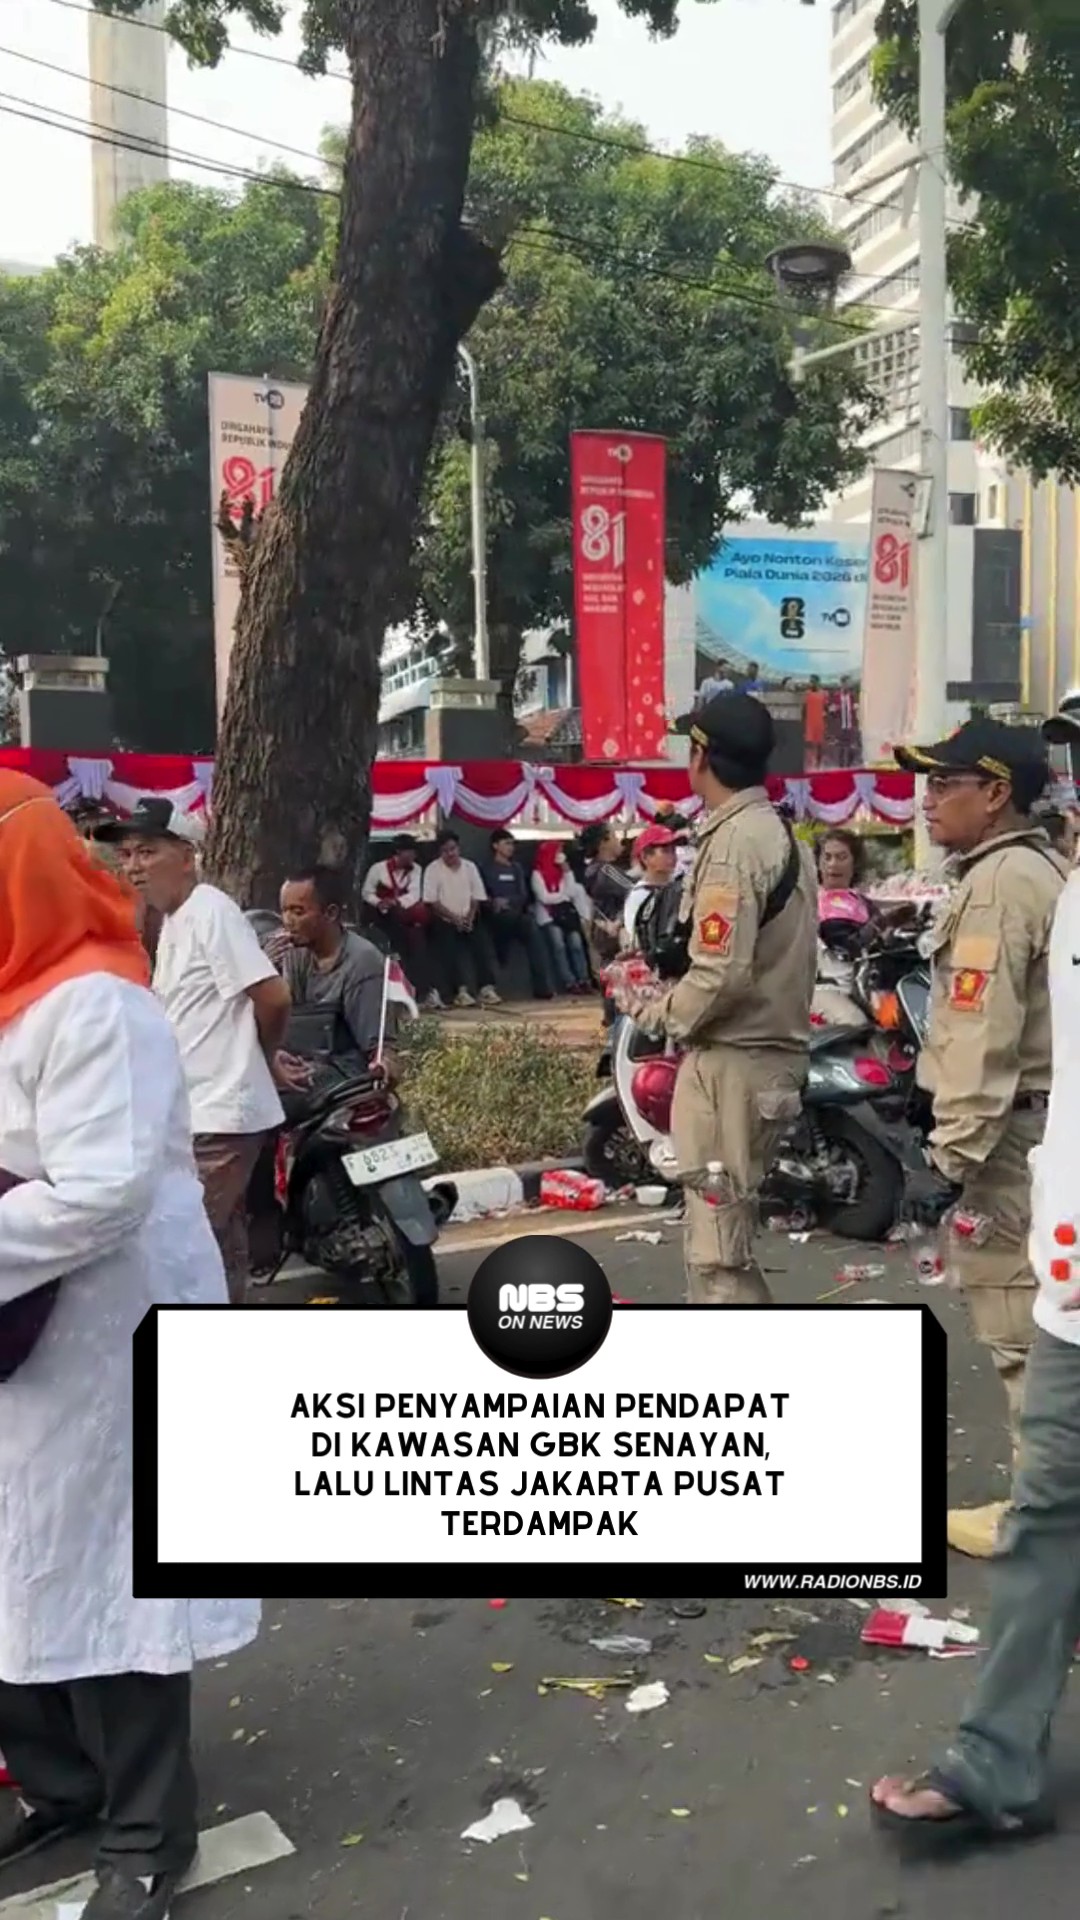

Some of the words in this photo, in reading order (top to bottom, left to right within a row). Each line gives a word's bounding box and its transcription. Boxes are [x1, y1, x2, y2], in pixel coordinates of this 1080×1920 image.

[580, 504, 626, 569] 81
[724, 567, 763, 580] Piala
[765, 568, 809, 581] Dunia
[812, 570, 852, 582] 2026
[731, 552, 761, 565] Ayo
[763, 552, 823, 565] Nonton
[874, 533, 911, 590] 81
